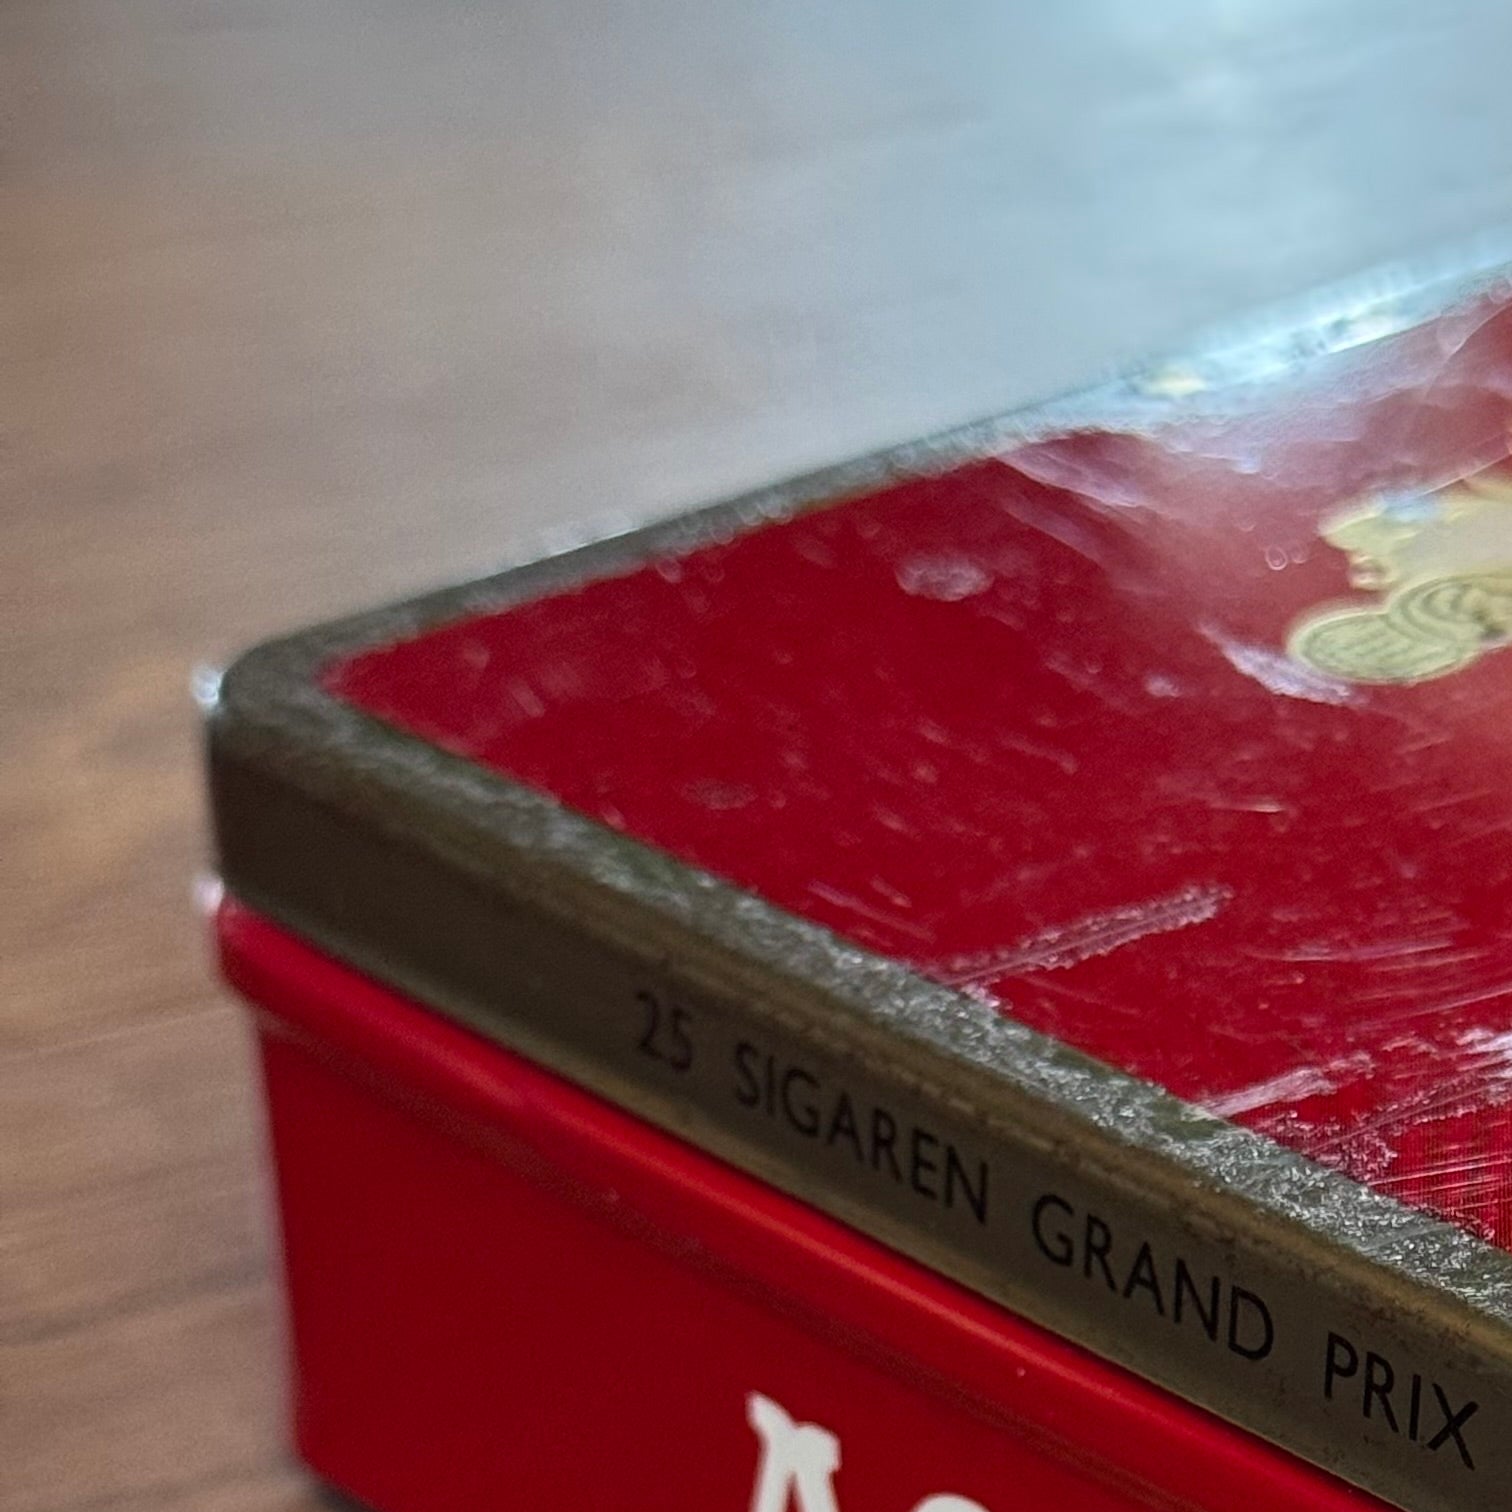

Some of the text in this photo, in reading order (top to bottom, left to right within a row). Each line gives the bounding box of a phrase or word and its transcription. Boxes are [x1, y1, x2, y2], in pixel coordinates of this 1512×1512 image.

[635, 990, 1479, 1471] 25 SIGAREN GRAND PRIX
